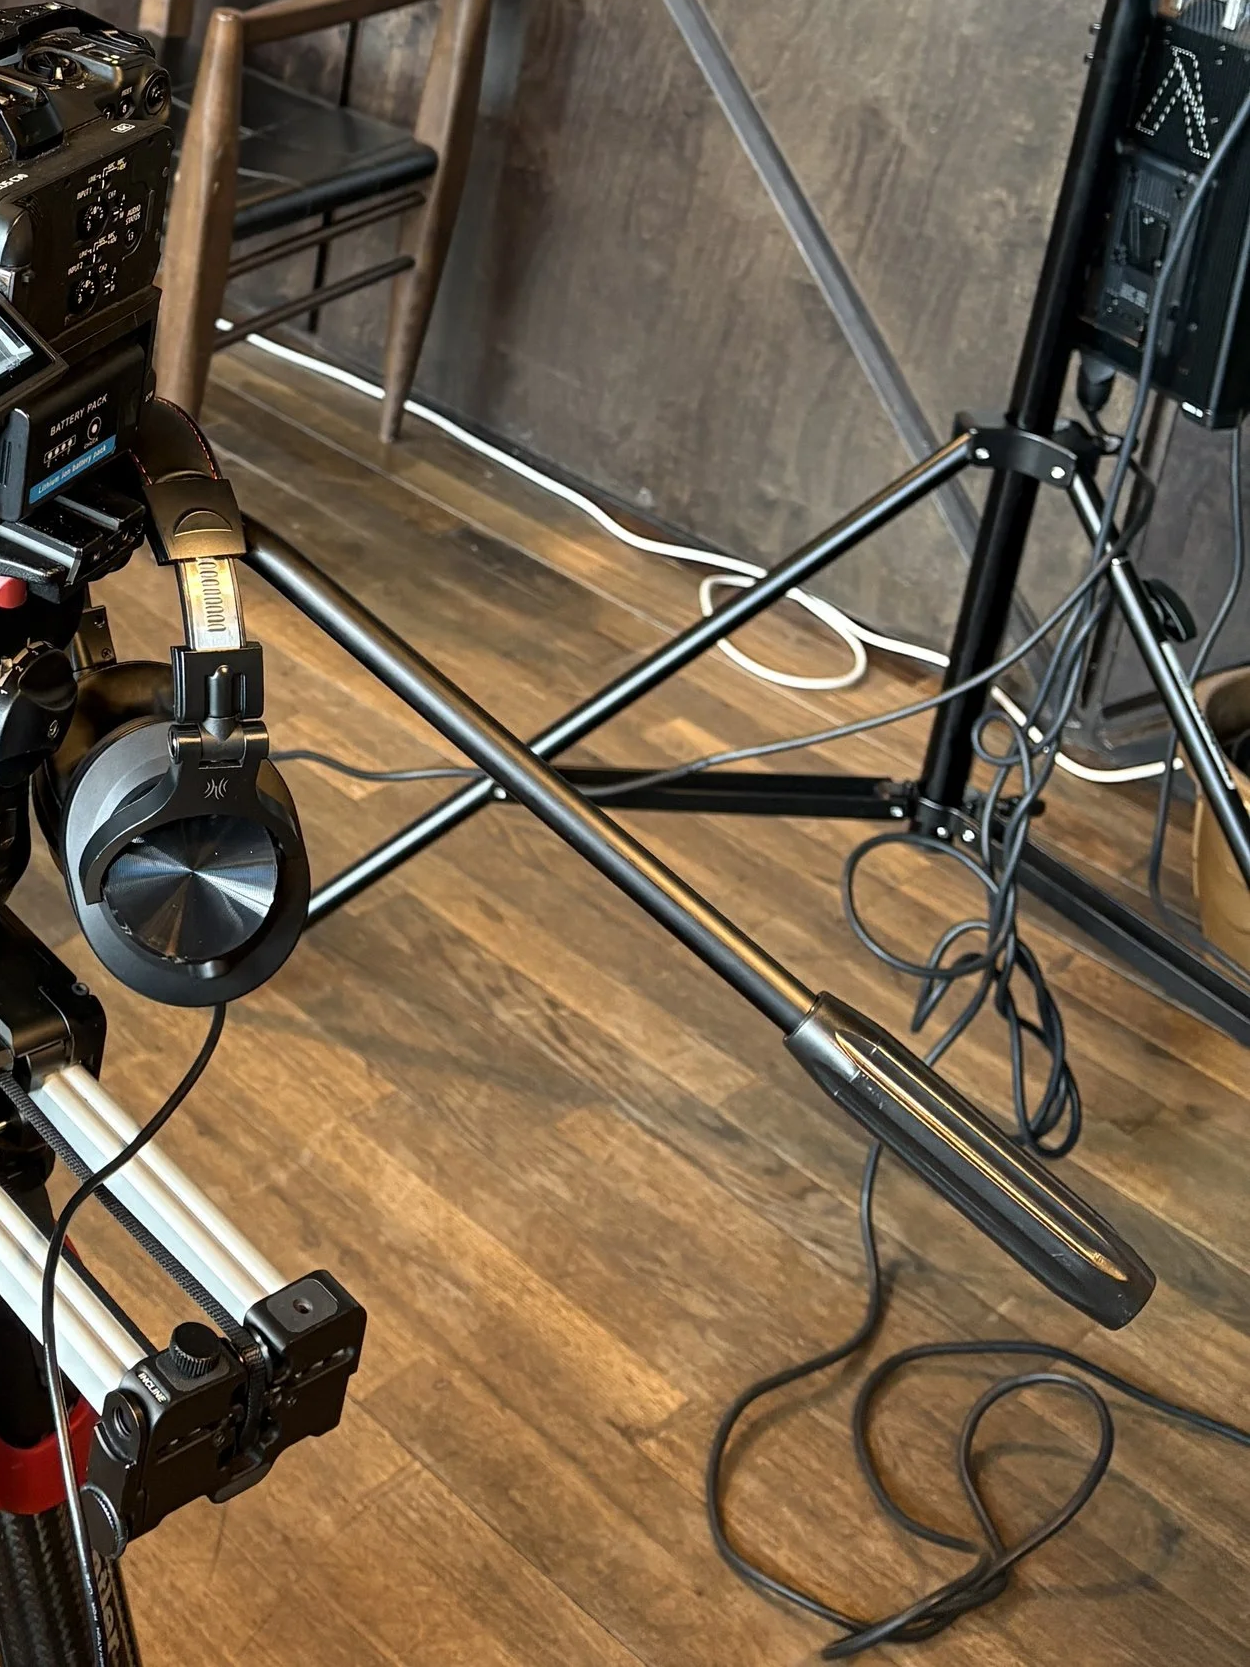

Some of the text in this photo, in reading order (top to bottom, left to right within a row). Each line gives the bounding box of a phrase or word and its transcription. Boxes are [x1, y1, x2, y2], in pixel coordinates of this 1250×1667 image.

[50, 393, 108, 436] BATTERY PACK
[72, 455, 92, 472] battery
[92, 444, 107, 458] pack
[137, 1372, 167, 1403] INCLINE
